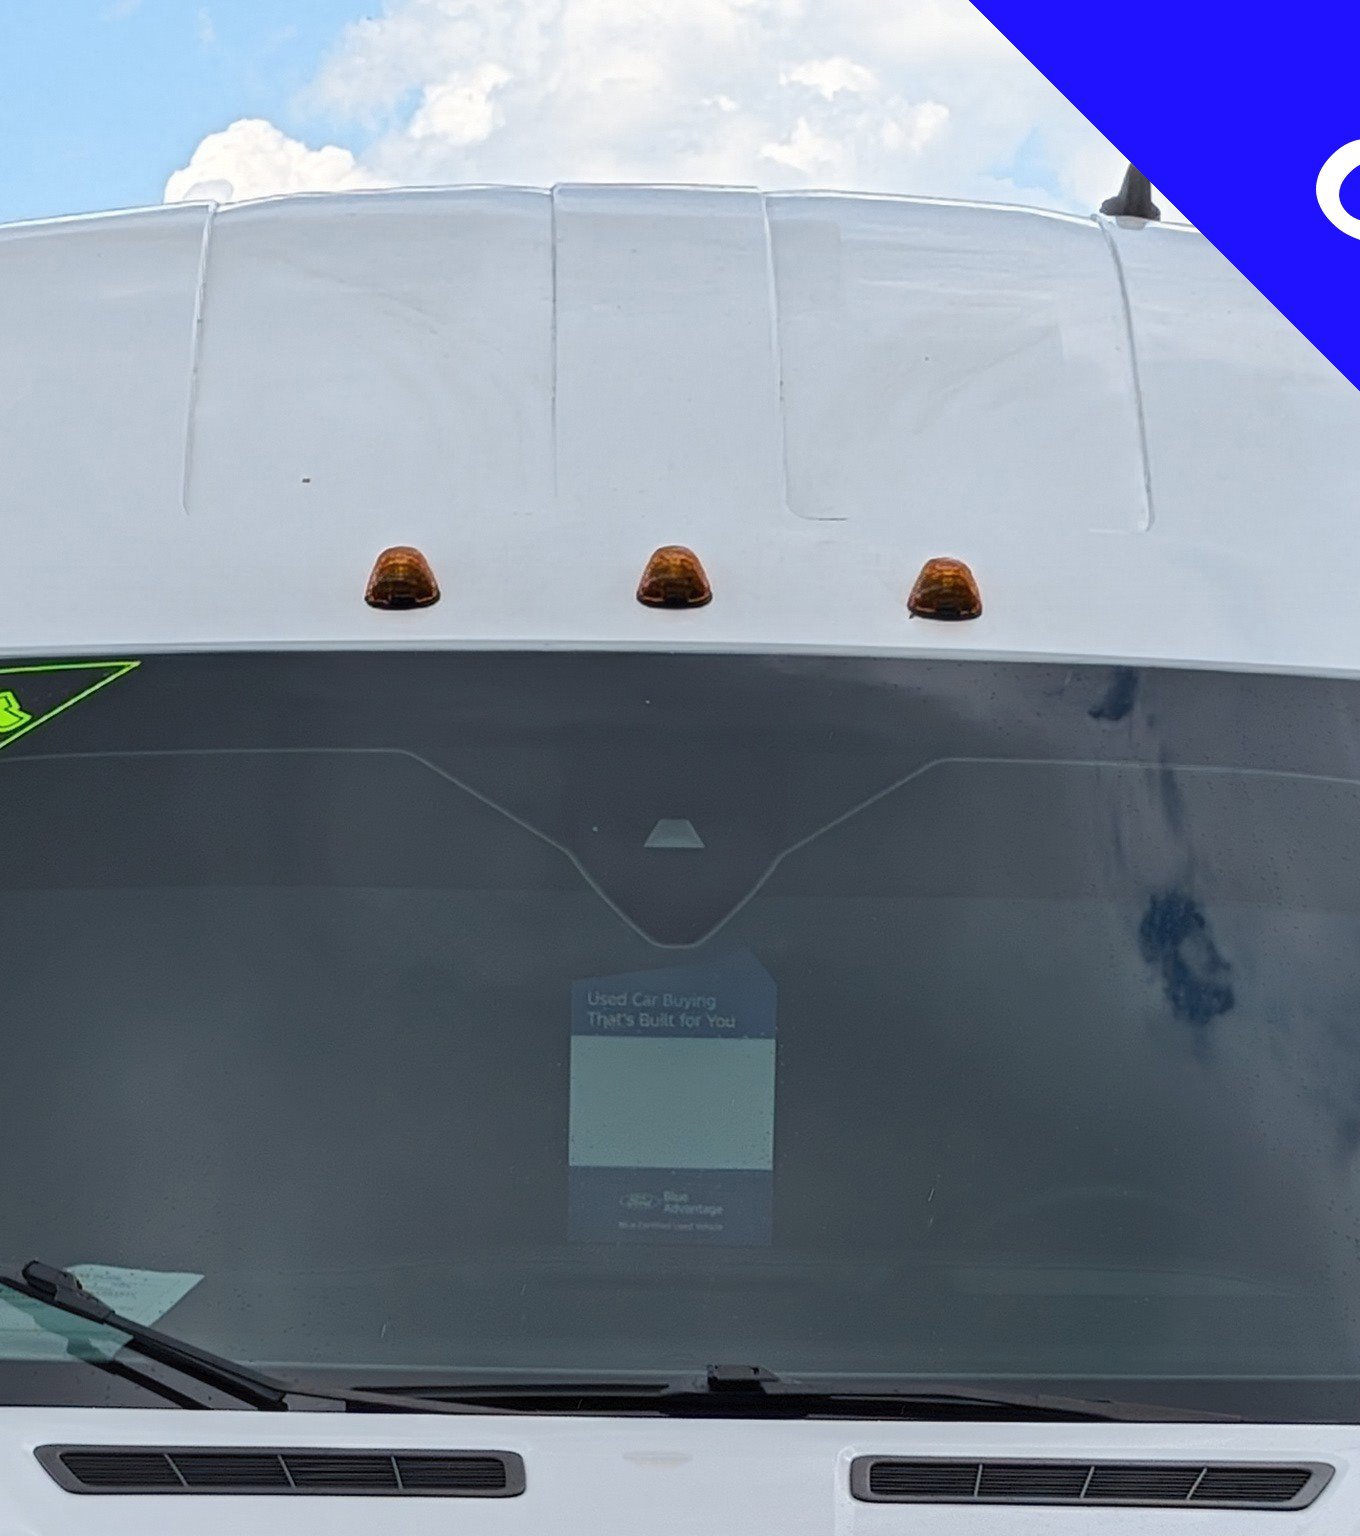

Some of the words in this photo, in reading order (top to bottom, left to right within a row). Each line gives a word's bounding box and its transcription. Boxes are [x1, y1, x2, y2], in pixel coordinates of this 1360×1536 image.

[587, 991, 627, 1007] Used
[632, 993, 658, 1008] Car
[662, 993, 717, 1011] Buying
[587, 1011, 635, 1028] That's
[639, 1013, 675, 1028] Built
[679, 1013, 701, 1028] for
[707, 1014, 736, 1029] You
